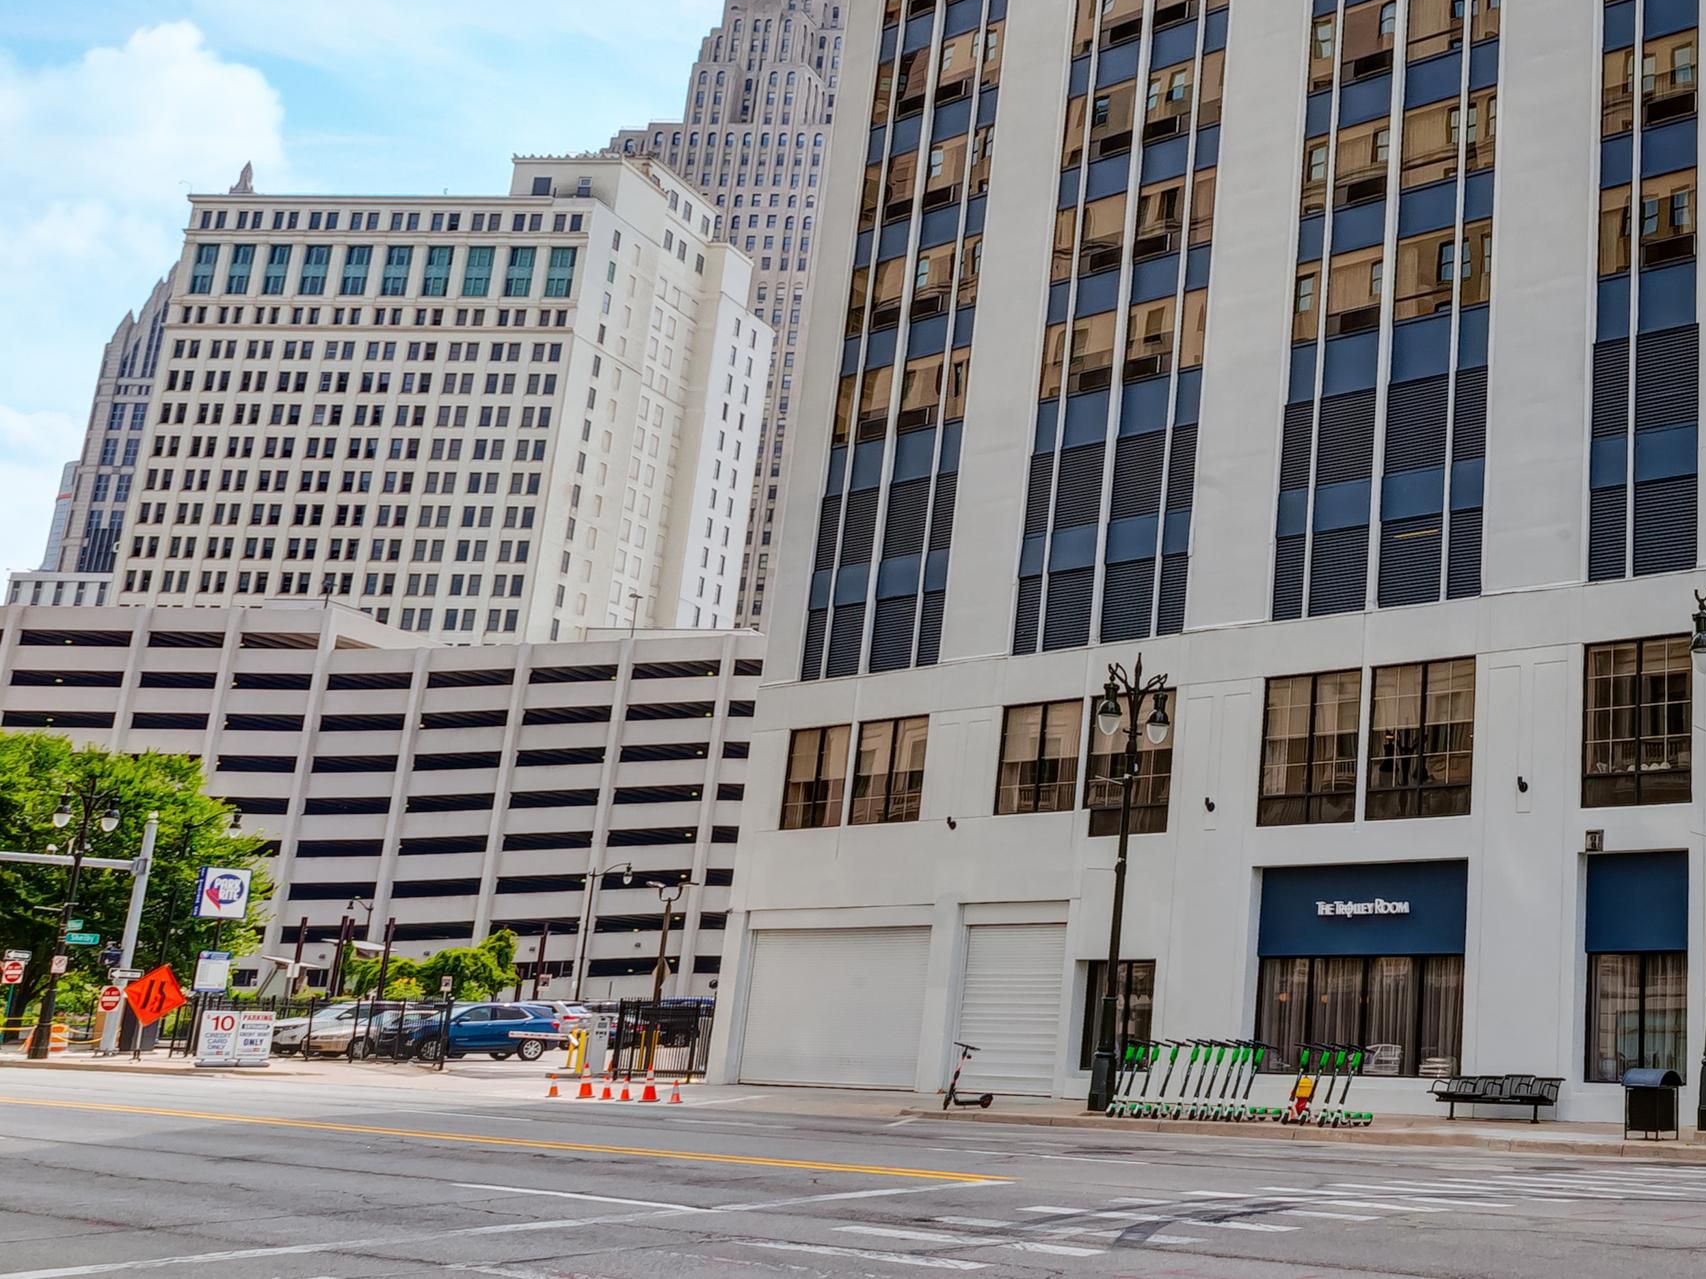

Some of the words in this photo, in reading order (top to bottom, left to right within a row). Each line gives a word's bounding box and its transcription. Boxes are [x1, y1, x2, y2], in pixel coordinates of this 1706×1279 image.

[1316, 901, 1334, 916] THE
[1333, 900, 1374, 918] TROLLEY
[1374, 898, 1410, 914] ROOM
[243, 1038, 264, 1046] ONLY
